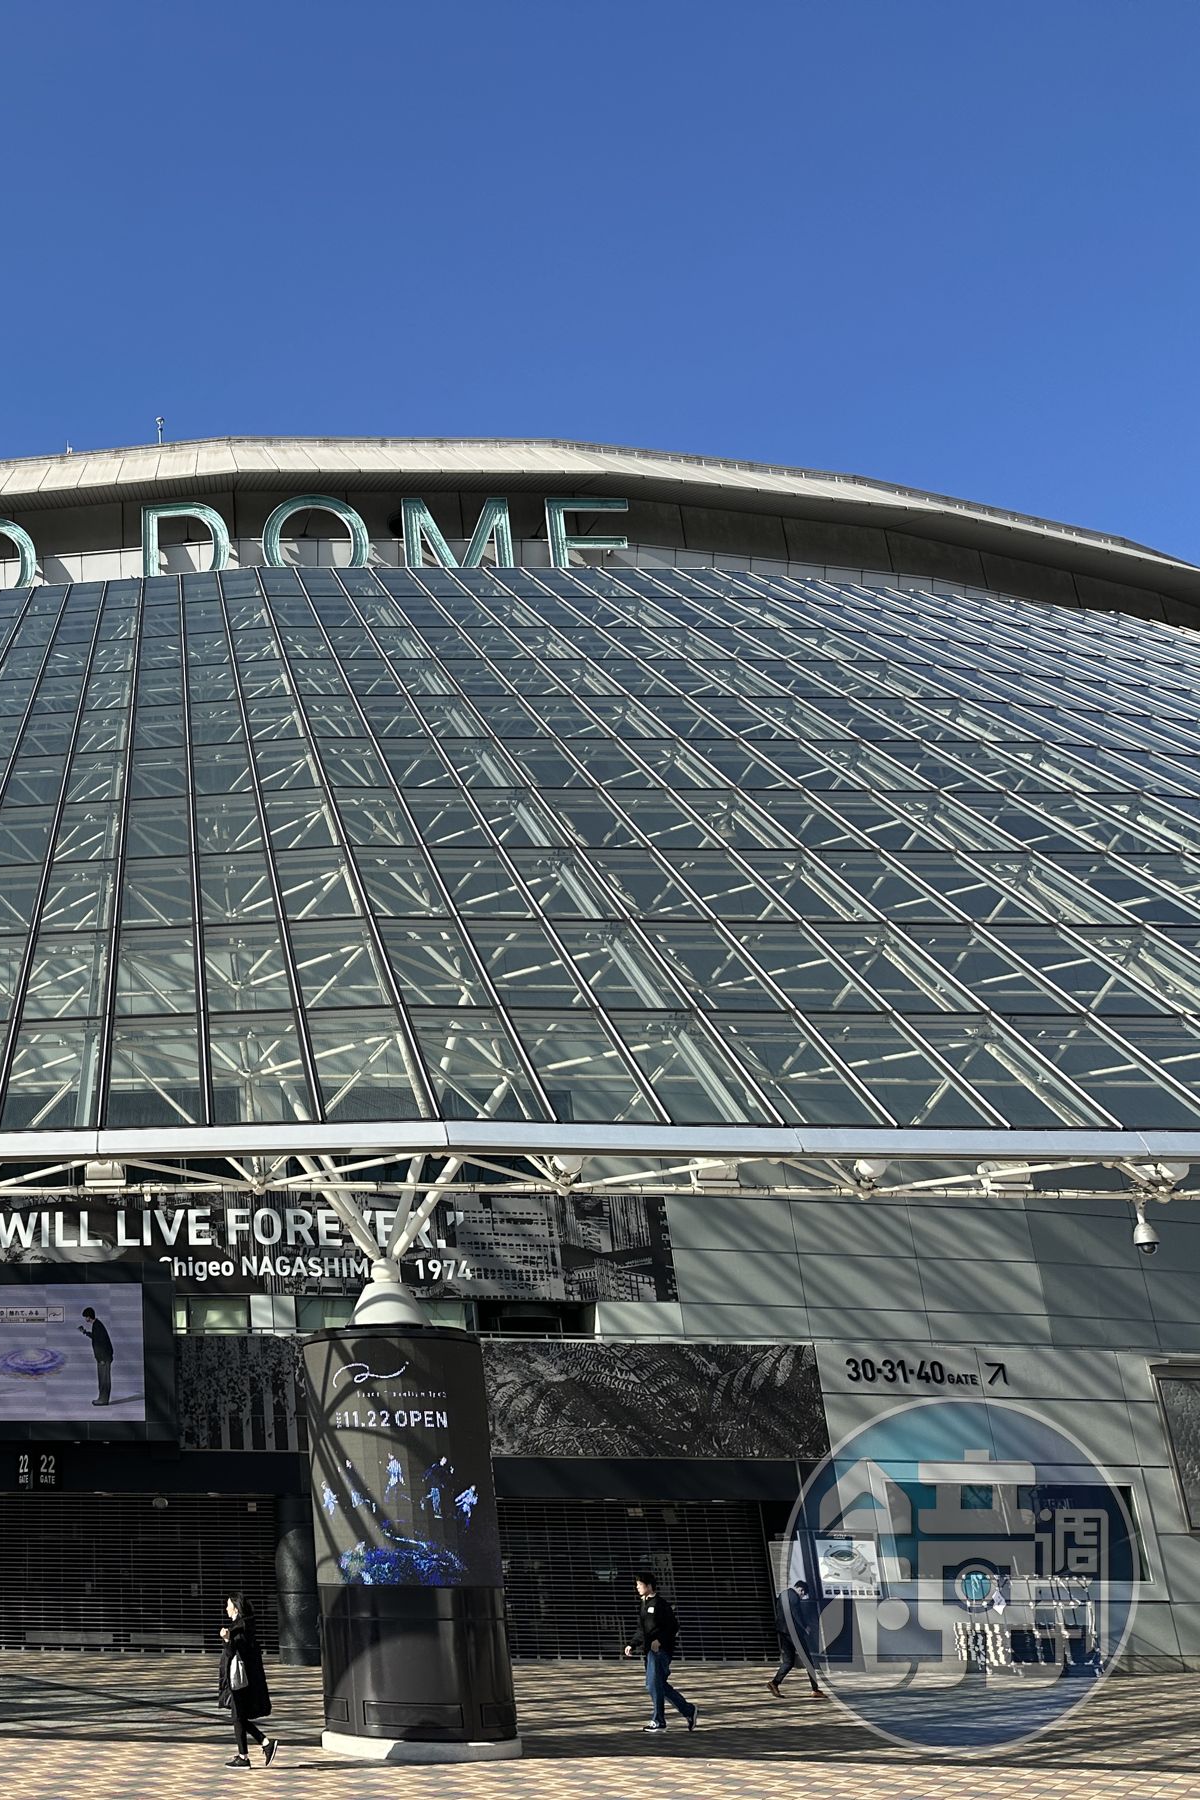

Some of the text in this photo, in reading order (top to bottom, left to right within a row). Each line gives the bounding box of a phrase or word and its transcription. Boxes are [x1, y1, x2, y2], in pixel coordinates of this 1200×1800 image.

[116, 1208, 212, 1247] LIVE
[415, 1258, 473, 1281] 1974
[947, 1373, 979, 1386] GATE
[343, 1410, 391, 1428] 11.22
[394, 1410, 449, 1429] OPEN
[19, 1454, 29, 1473] 22
[40, 1454, 56, 1473] 22
[40, 1474, 56, 1485] GATE
